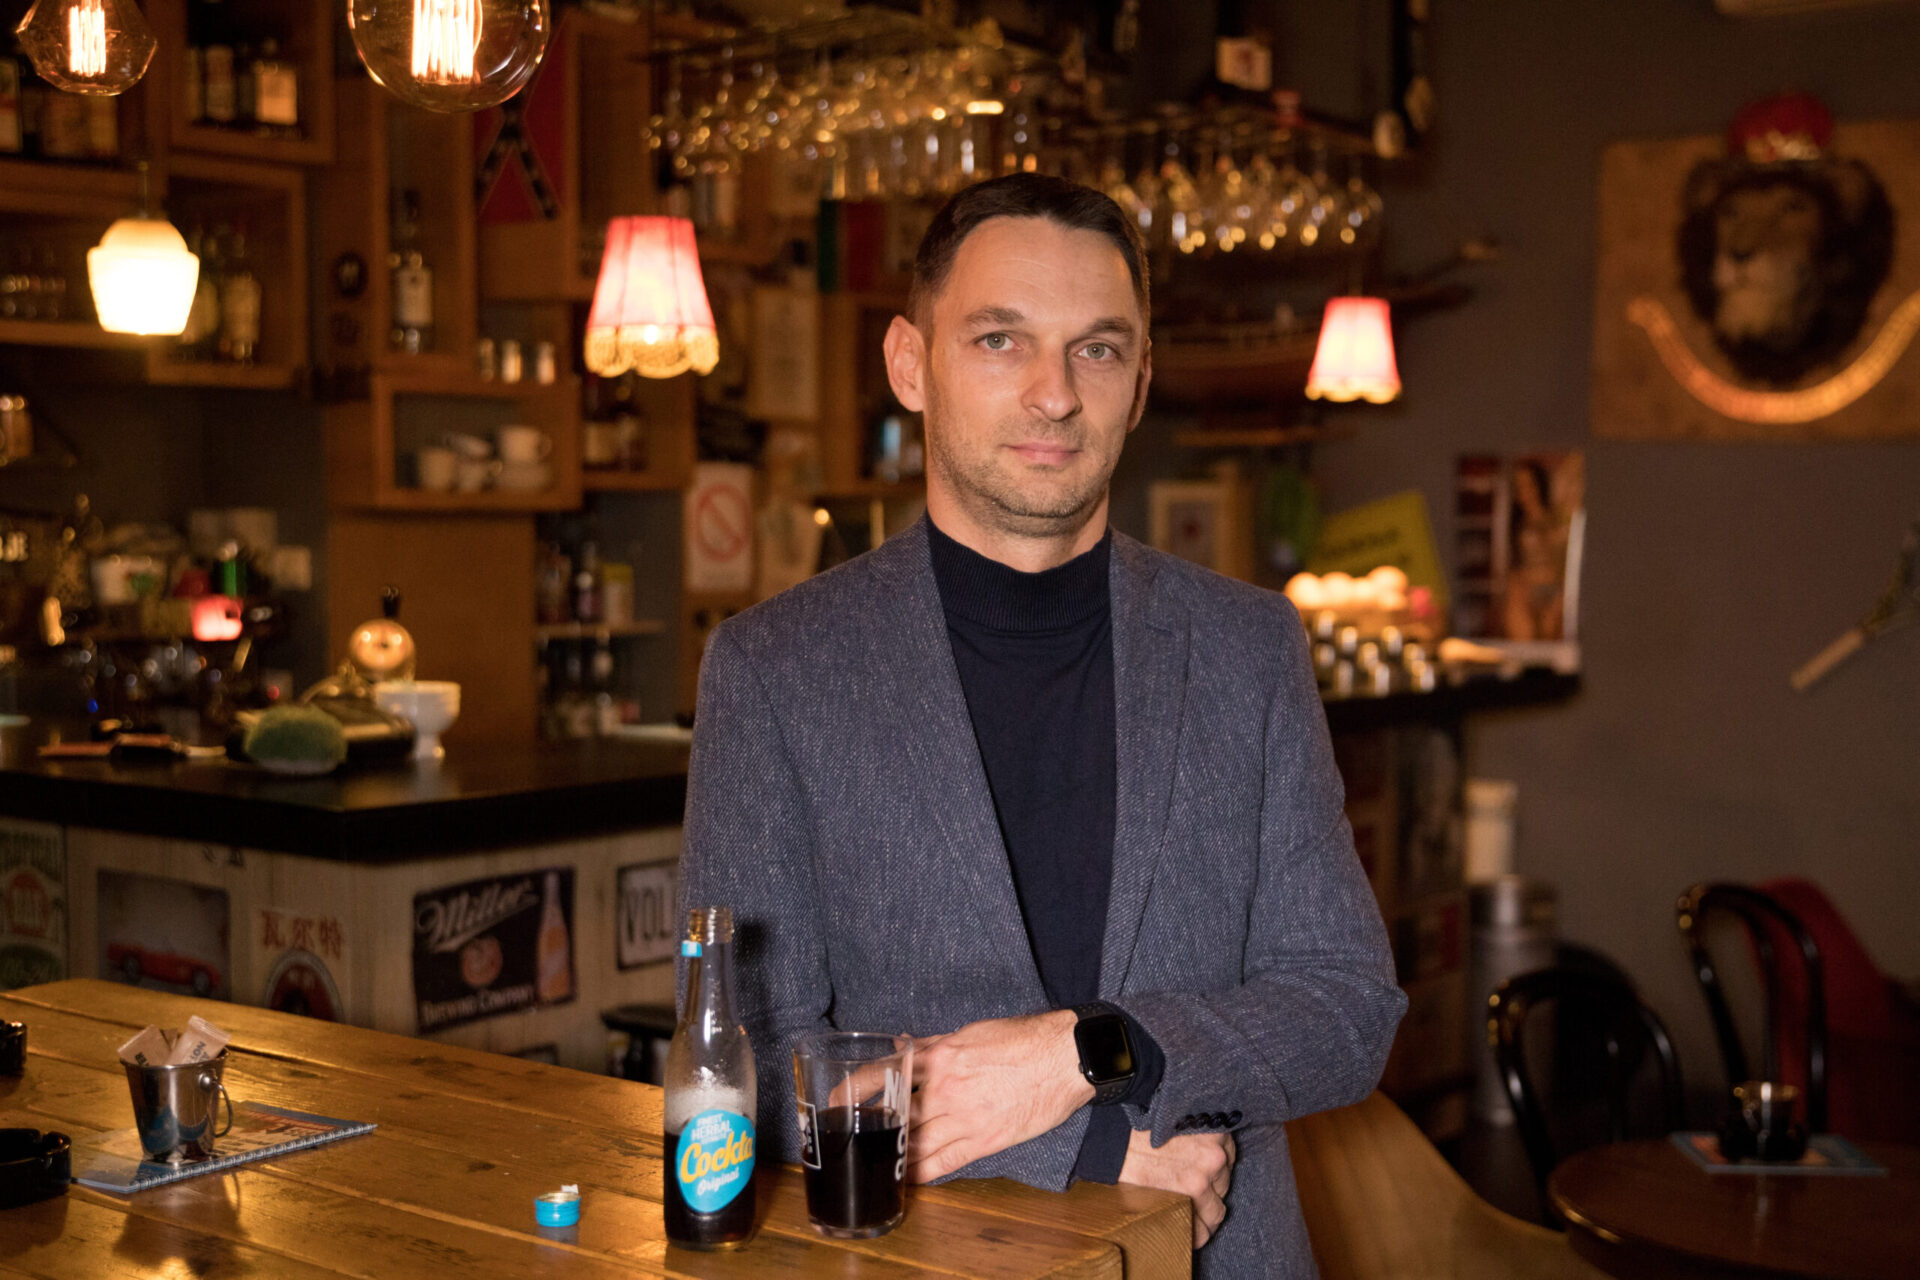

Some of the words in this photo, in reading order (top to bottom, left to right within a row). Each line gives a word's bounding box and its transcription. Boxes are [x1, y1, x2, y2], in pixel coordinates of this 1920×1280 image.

[416, 877, 541, 953] Miller
[621, 880, 673, 933] VOL
[680, 1130, 754, 1184] Cockta
[696, 1166, 740, 1197] Original
